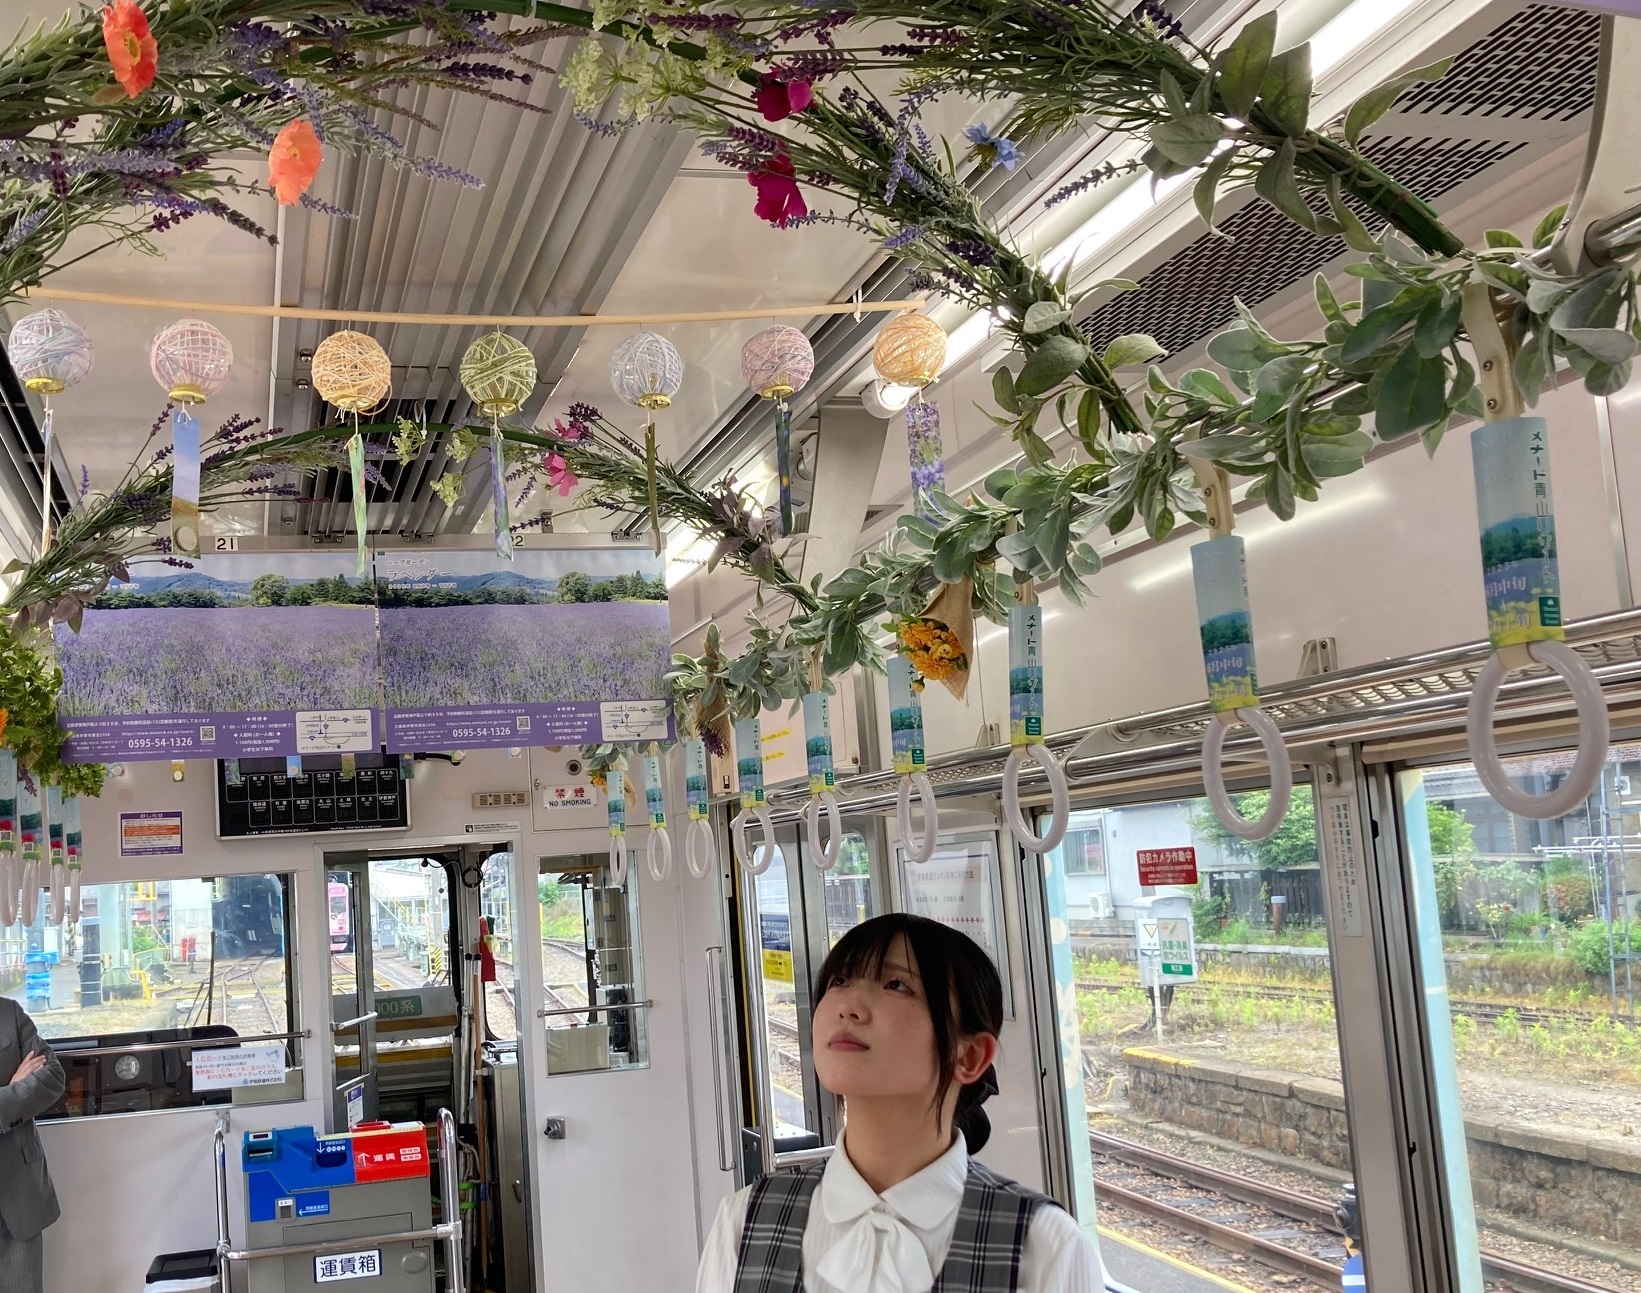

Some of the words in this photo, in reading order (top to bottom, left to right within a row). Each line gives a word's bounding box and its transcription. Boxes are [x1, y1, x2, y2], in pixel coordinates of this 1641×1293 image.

[216, 537, 234, 550] 21
[387, 567, 454, 581] ラベンダー
[452, 727, 511, 738] 0595-54-1326
[128, 737, 193, 748] 0595-54-1326
[554, 787, 585, 799] 禁煙
[561, 798, 592, 807] SMOKING
[1139, 849, 1193, 864] 防犯カメラ作動中
[1140, 865, 1155, 873] Security
[320, 1254, 376, 1279] 運賃箱
